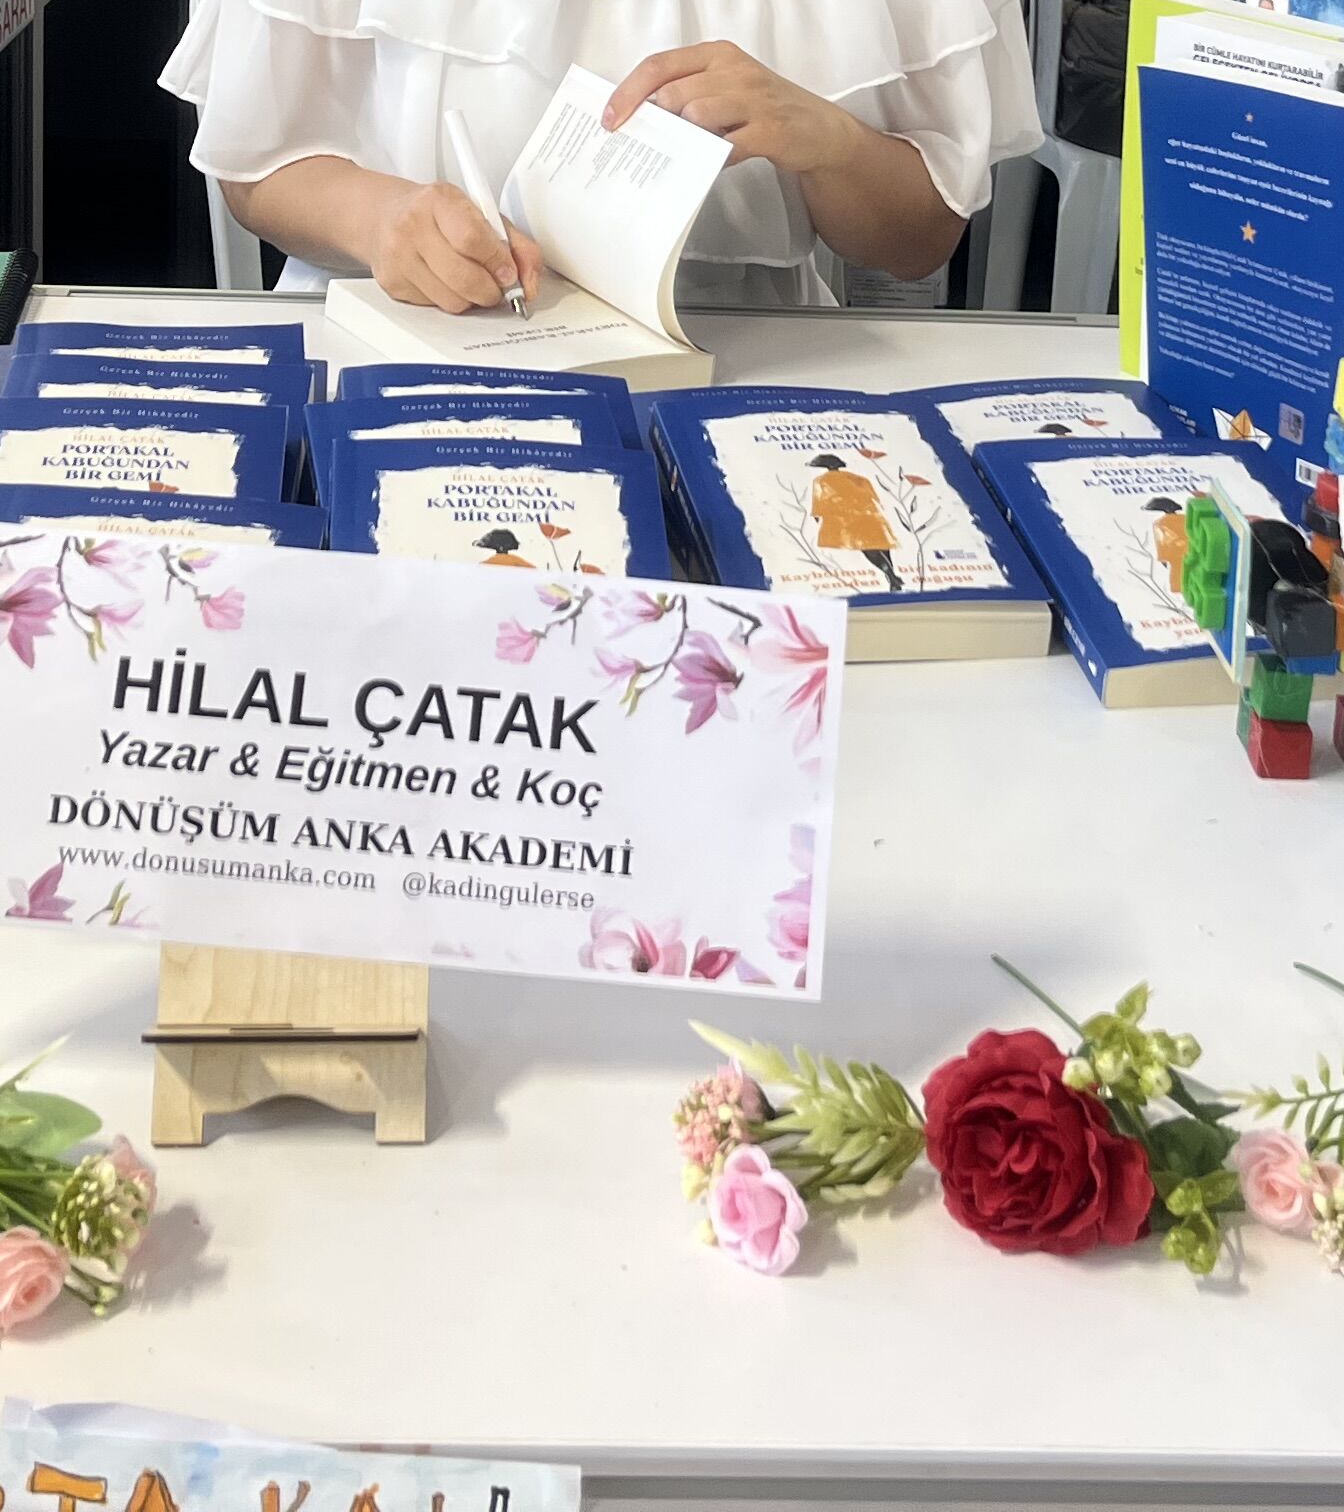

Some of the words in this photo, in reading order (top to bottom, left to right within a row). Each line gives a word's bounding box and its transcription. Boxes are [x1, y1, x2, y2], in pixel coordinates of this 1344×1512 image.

[763, 423, 866, 434] PORTAKAL
[61, 444, 176, 458] PORTAKAL
[781, 441, 815, 451] BİR
[42, 455, 191, 471] KABUĞUNDAN
[65, 469, 103, 482] BİR
[107, 467, 163, 482] GEMİ
[1091, 467, 1195, 478] PORTAKAL
[444, 484, 559, 497] PORTAKAL
[1112, 484, 1147, 496] BİR
[427, 496, 576, 512] KABUĞUNDAN
[453, 510, 491, 522] BİR
[496, 509, 551, 524] GEMİ
[112, 647, 329, 728] HİLAL
[355, 677, 600, 754] ÇATAK
[100, 728, 220, 773] Yazar
[229, 741, 260, 778] &
[274, 745, 458, 795] Eğitmen
[470, 763, 501, 800] &
[516, 767, 604, 818] Koç
[47, 789, 281, 844] DÖNÜŞÜM
[292, 815, 414, 857] ANKA
[427, 828, 635, 878] AKADEMİ
[58, 844, 377, 892] www.donusumanka.com
[402, 870, 595, 910] @kadingulerse
